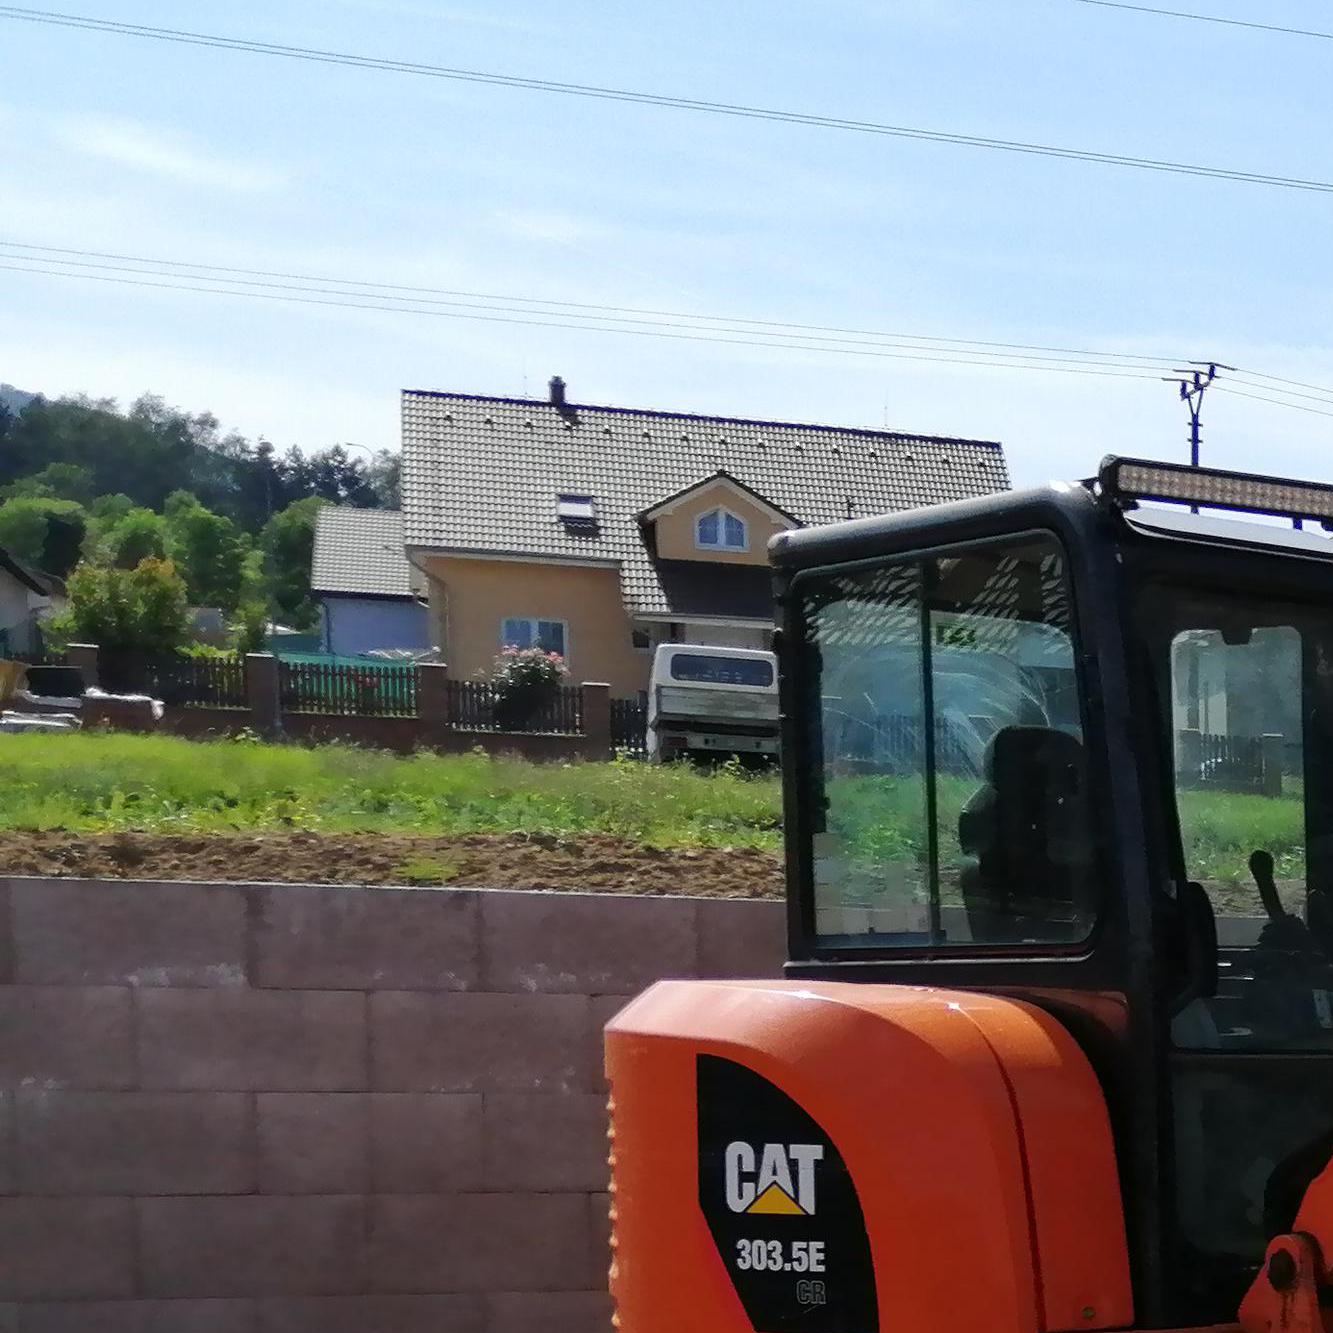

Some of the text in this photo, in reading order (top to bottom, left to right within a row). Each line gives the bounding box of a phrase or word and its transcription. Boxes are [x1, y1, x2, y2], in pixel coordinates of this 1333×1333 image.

[725, 1140, 824, 1216] CAT
[736, 1239, 826, 1273] 303.5E
[796, 1279, 827, 1305] CR
